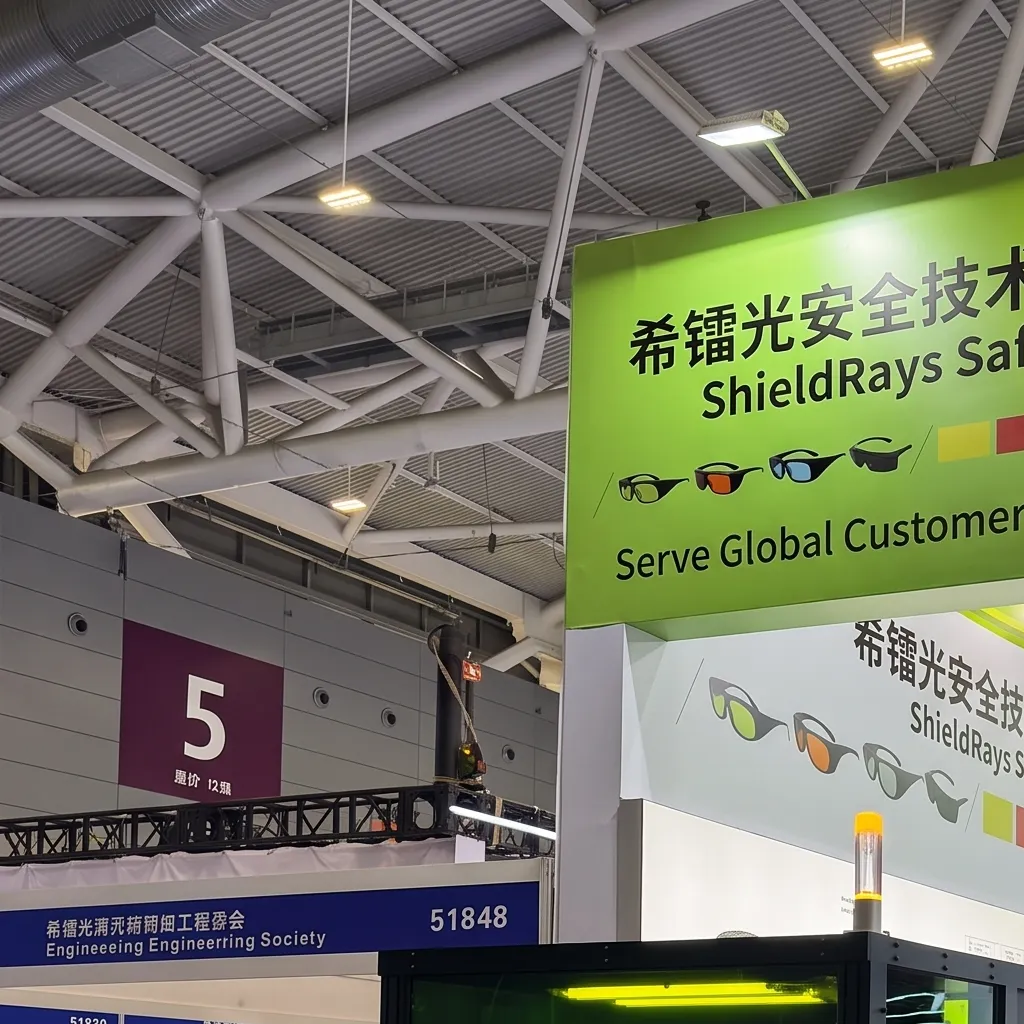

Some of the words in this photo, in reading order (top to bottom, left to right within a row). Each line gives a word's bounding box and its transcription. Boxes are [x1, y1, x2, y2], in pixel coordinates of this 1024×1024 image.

[701, 351, 943, 420] ShieldRays
[615, 545, 710, 582] Serve
[719, 519, 833, 568] Global
[183, 673, 226, 761] 5
[909, 701, 1012, 776] ShieldRays
[46, 939, 144, 960] Engineeeing
[148, 933, 256, 955] Engineerring
[260, 930, 327, 949] Society
[430, 904, 508, 932] 51848
